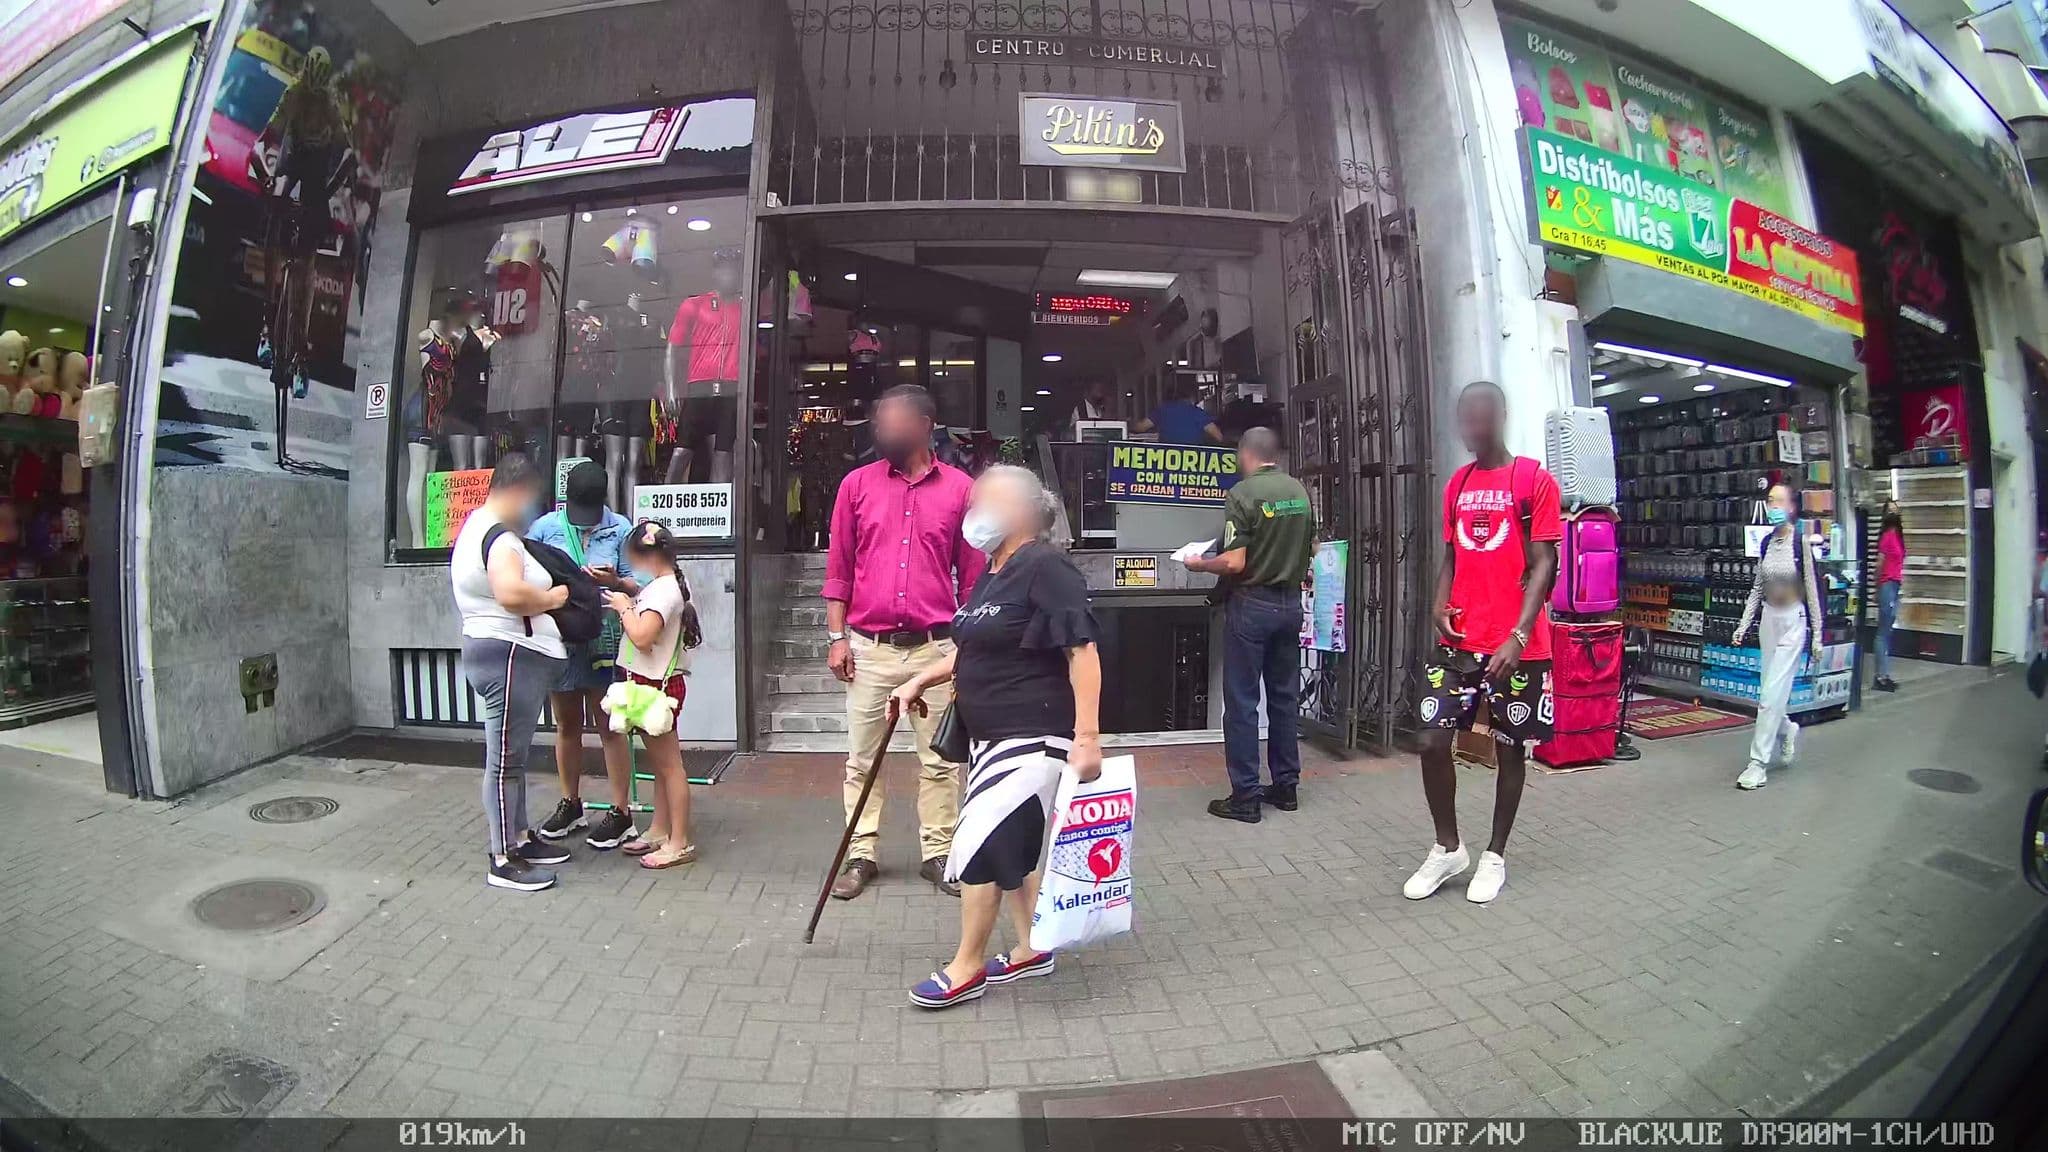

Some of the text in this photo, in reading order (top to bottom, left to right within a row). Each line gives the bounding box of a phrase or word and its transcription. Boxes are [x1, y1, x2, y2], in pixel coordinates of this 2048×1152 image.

[976, 38, 1217, 69] CENTRO COMERCIAL
[1527, 32, 1577, 64] Bolsos
[1041, 105, 1165, 150] Pikin's
[1536, 139, 1681, 214] Distribolsos
[1573, 186, 1606, 232] &
[1610, 198, 1675, 252] Más
[1551, 227, 1570, 241] Cra
[1572, 232, 1578, 244] 7
[1655, 254, 1695, 275] VENTAS
[1697, 268, 1709, 280] AL
[1711, 271, 1729, 286] POR
[1731, 279, 1760, 294] MAYOR
[1042, 314, 1099, 324] BIENVENIDOS
[1112, 446, 1237, 474] MEMORIAS
[1110, 482, 1126, 492] SE
[1130, 484, 1175, 495] GRABAN
[1136, 471, 1218, 487] CON MUSICA
[652, 492, 728, 509] 320 568 5573
[1461, 503, 1506, 512] HERITAGE
[1115, 559, 1155, 569] SE ALQUILA
[1064, 798, 1132, 827] MODA
[1052, 883, 1129, 912] Kalendar
